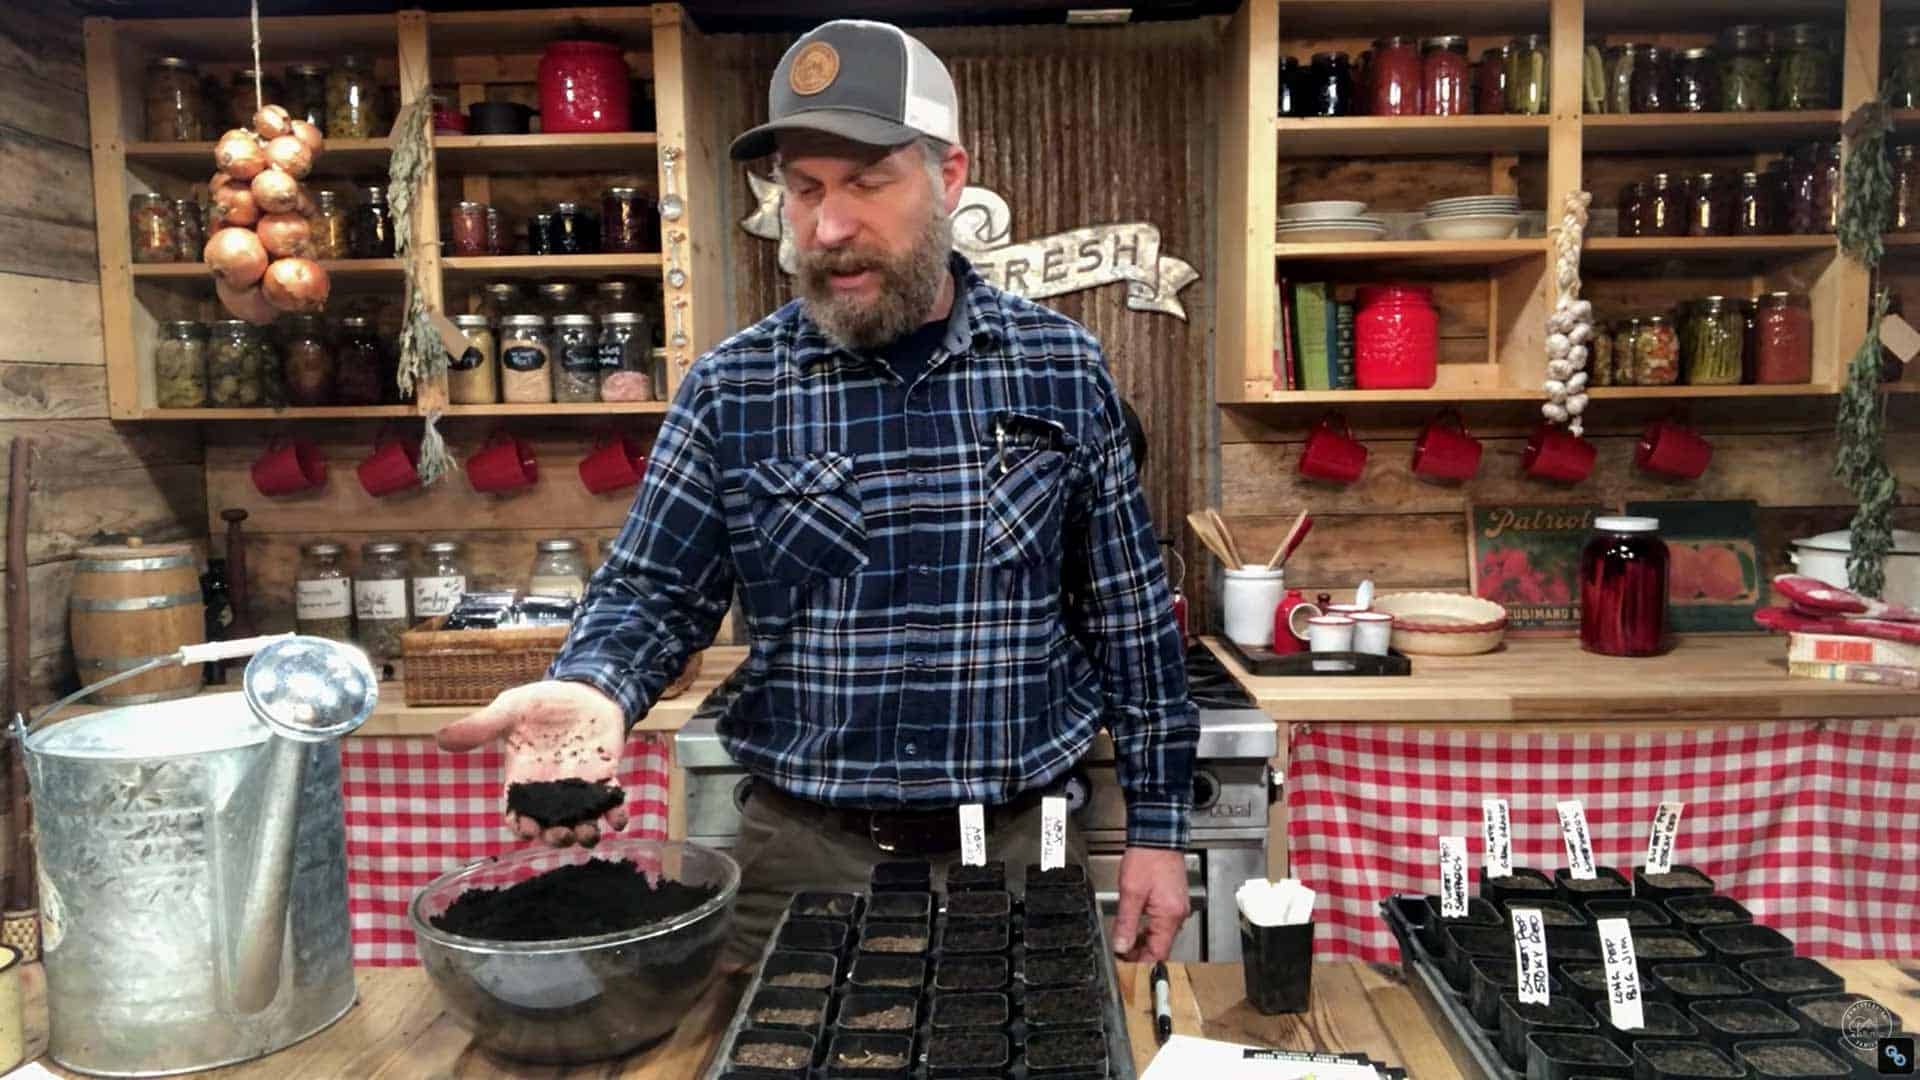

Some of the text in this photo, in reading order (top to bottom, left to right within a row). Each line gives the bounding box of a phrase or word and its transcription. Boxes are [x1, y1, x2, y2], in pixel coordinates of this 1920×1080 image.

[1483, 508, 1592, 538] Patriot
[1521, 945, 1534, 995] SWEET
[1621, 936, 1638, 1001] BIG JIM
